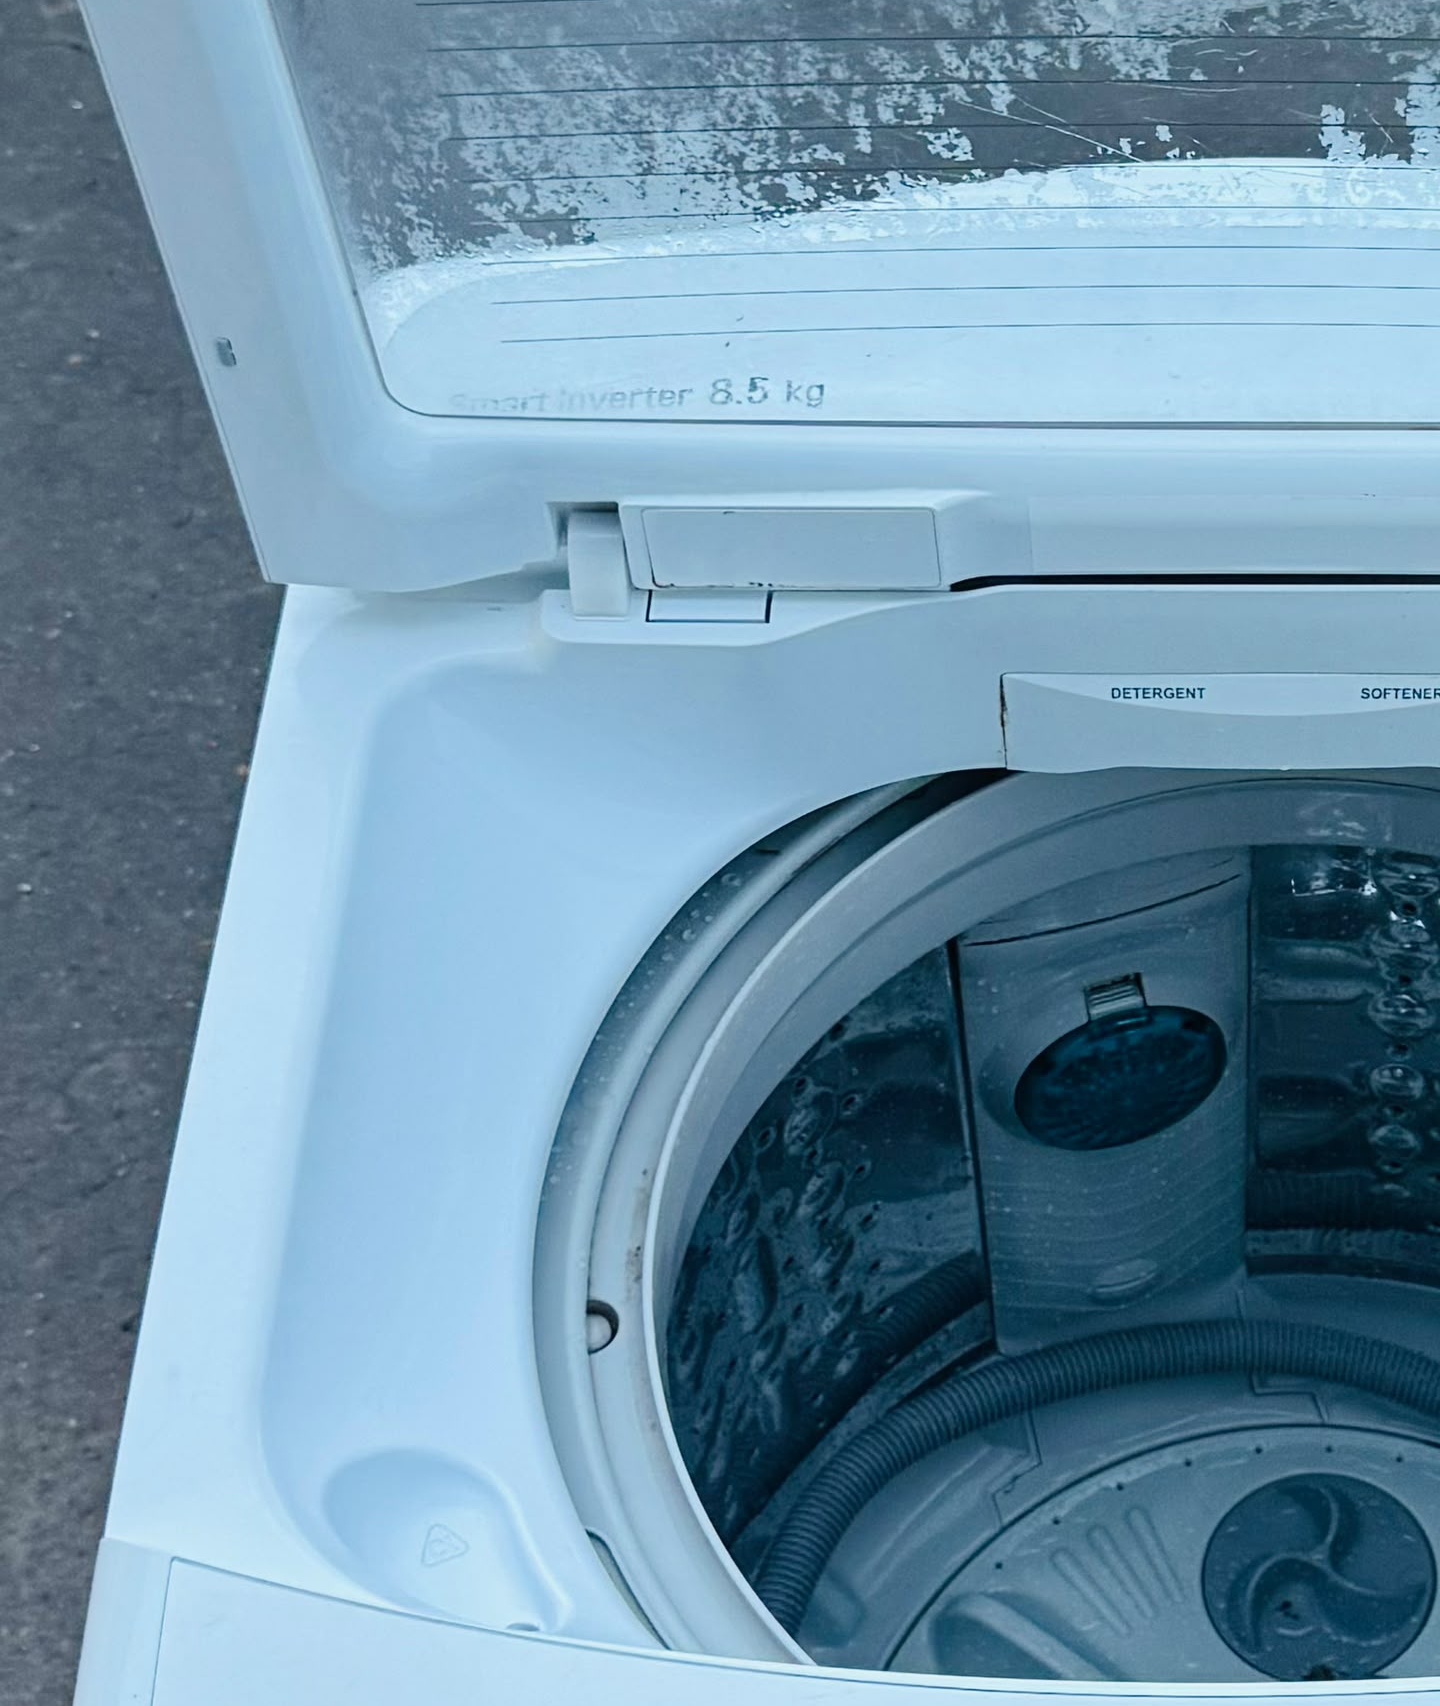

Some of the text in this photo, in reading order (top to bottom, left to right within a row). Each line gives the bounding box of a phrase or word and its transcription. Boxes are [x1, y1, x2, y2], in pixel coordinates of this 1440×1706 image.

[709, 375, 769, 406] 8.5
[784, 378, 825, 407] kg
[1111, 687, 1206, 700] DETERGENT
